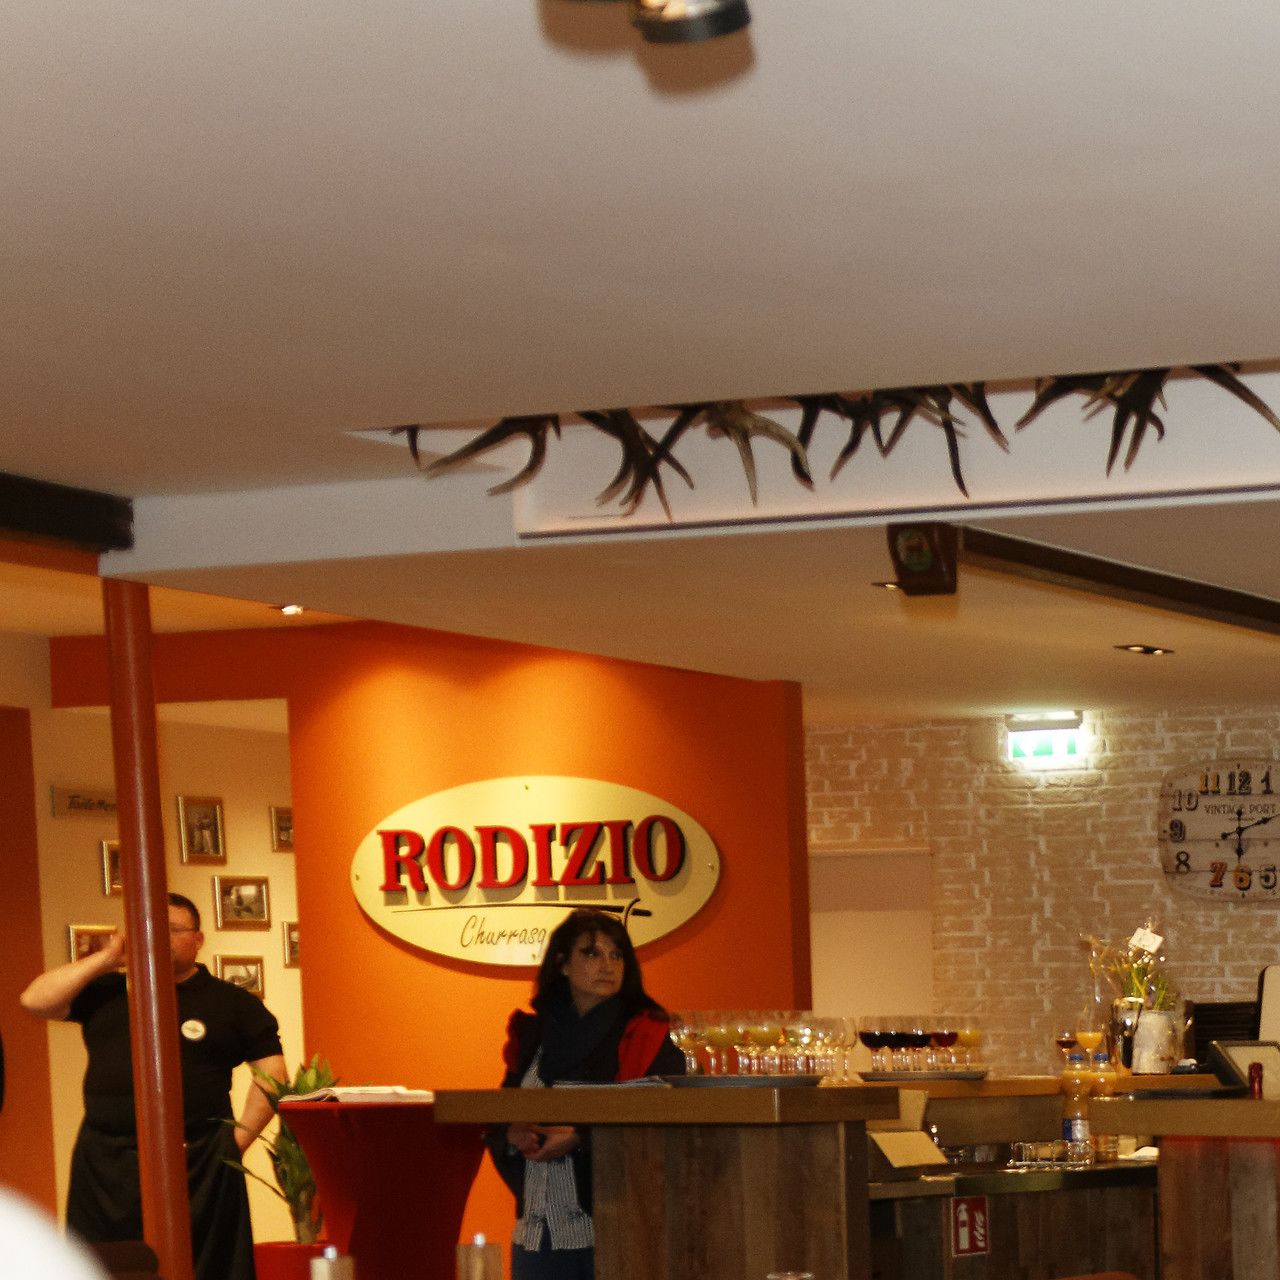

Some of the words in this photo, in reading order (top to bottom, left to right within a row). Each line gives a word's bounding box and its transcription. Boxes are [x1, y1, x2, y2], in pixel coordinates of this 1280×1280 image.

[1200, 772, 1220, 795] 11
[1227, 771, 1251, 795] 12
[1261, 770, 1273, 794] 1
[1172, 789, 1198, 811] 10
[1204, 804, 1246, 814] VINTAE
[1169, 819, 1186, 843] 9
[377, 814, 686, 892] RODIZIO
[1176, 851, 1191, 874] 8
[1210, 861, 1228, 887] 7
[1232, 864, 1252, 891] 6
[1259, 864, 1277, 889] 5
[460, 914, 547, 960] Churrasq
